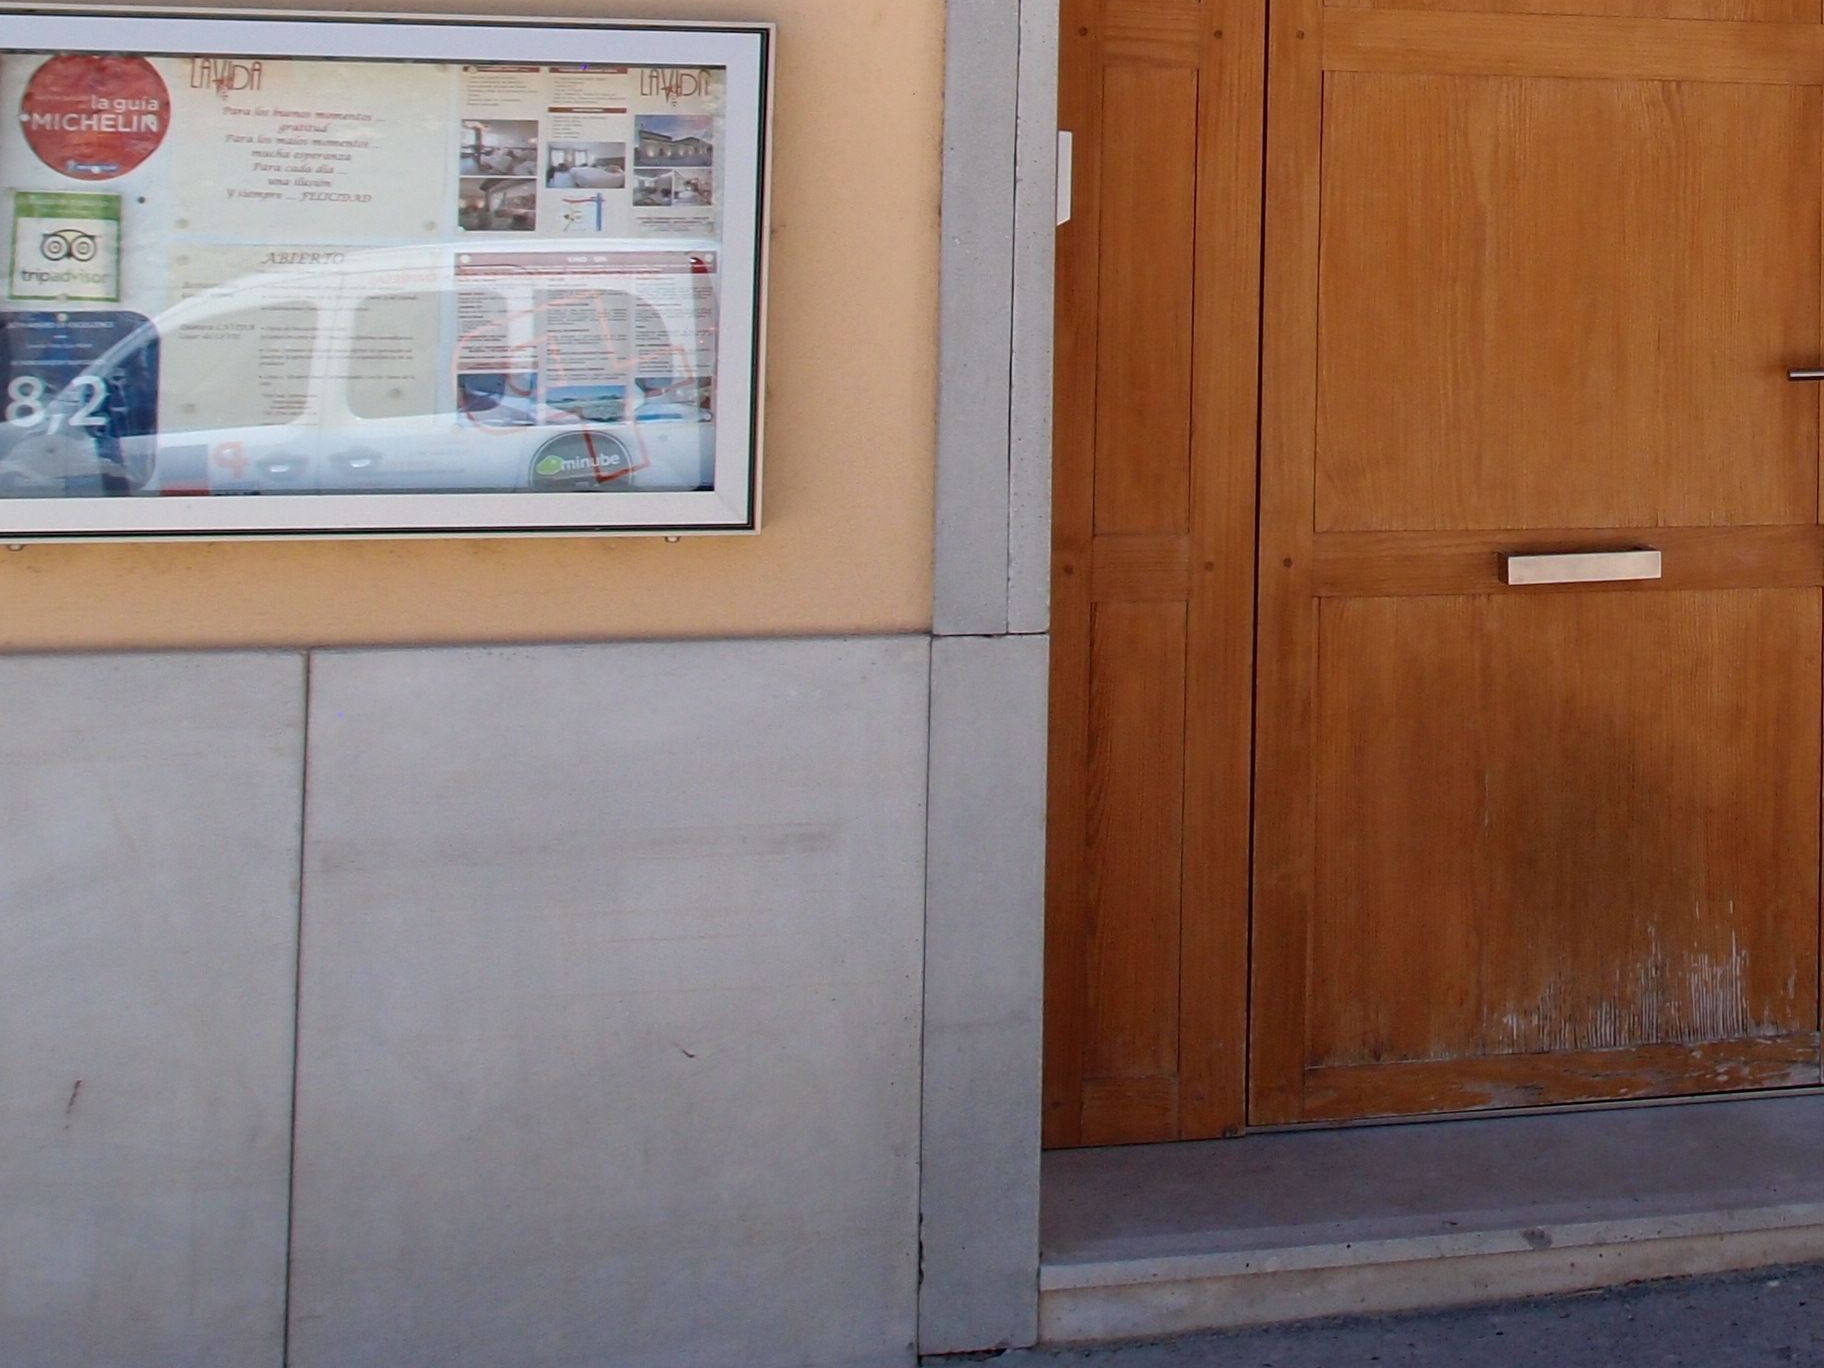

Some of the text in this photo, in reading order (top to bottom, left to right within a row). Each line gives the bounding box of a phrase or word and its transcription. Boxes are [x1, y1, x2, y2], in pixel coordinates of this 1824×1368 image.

[91, 95, 108, 109] la
[31, 113, 158, 132] MICHELIN
[261, 251, 345, 266] ABIERTO
[21, 269, 114, 286] tripadvisor
[5, 375, 112, 436] 8,2
[561, 453, 620, 471] minube
